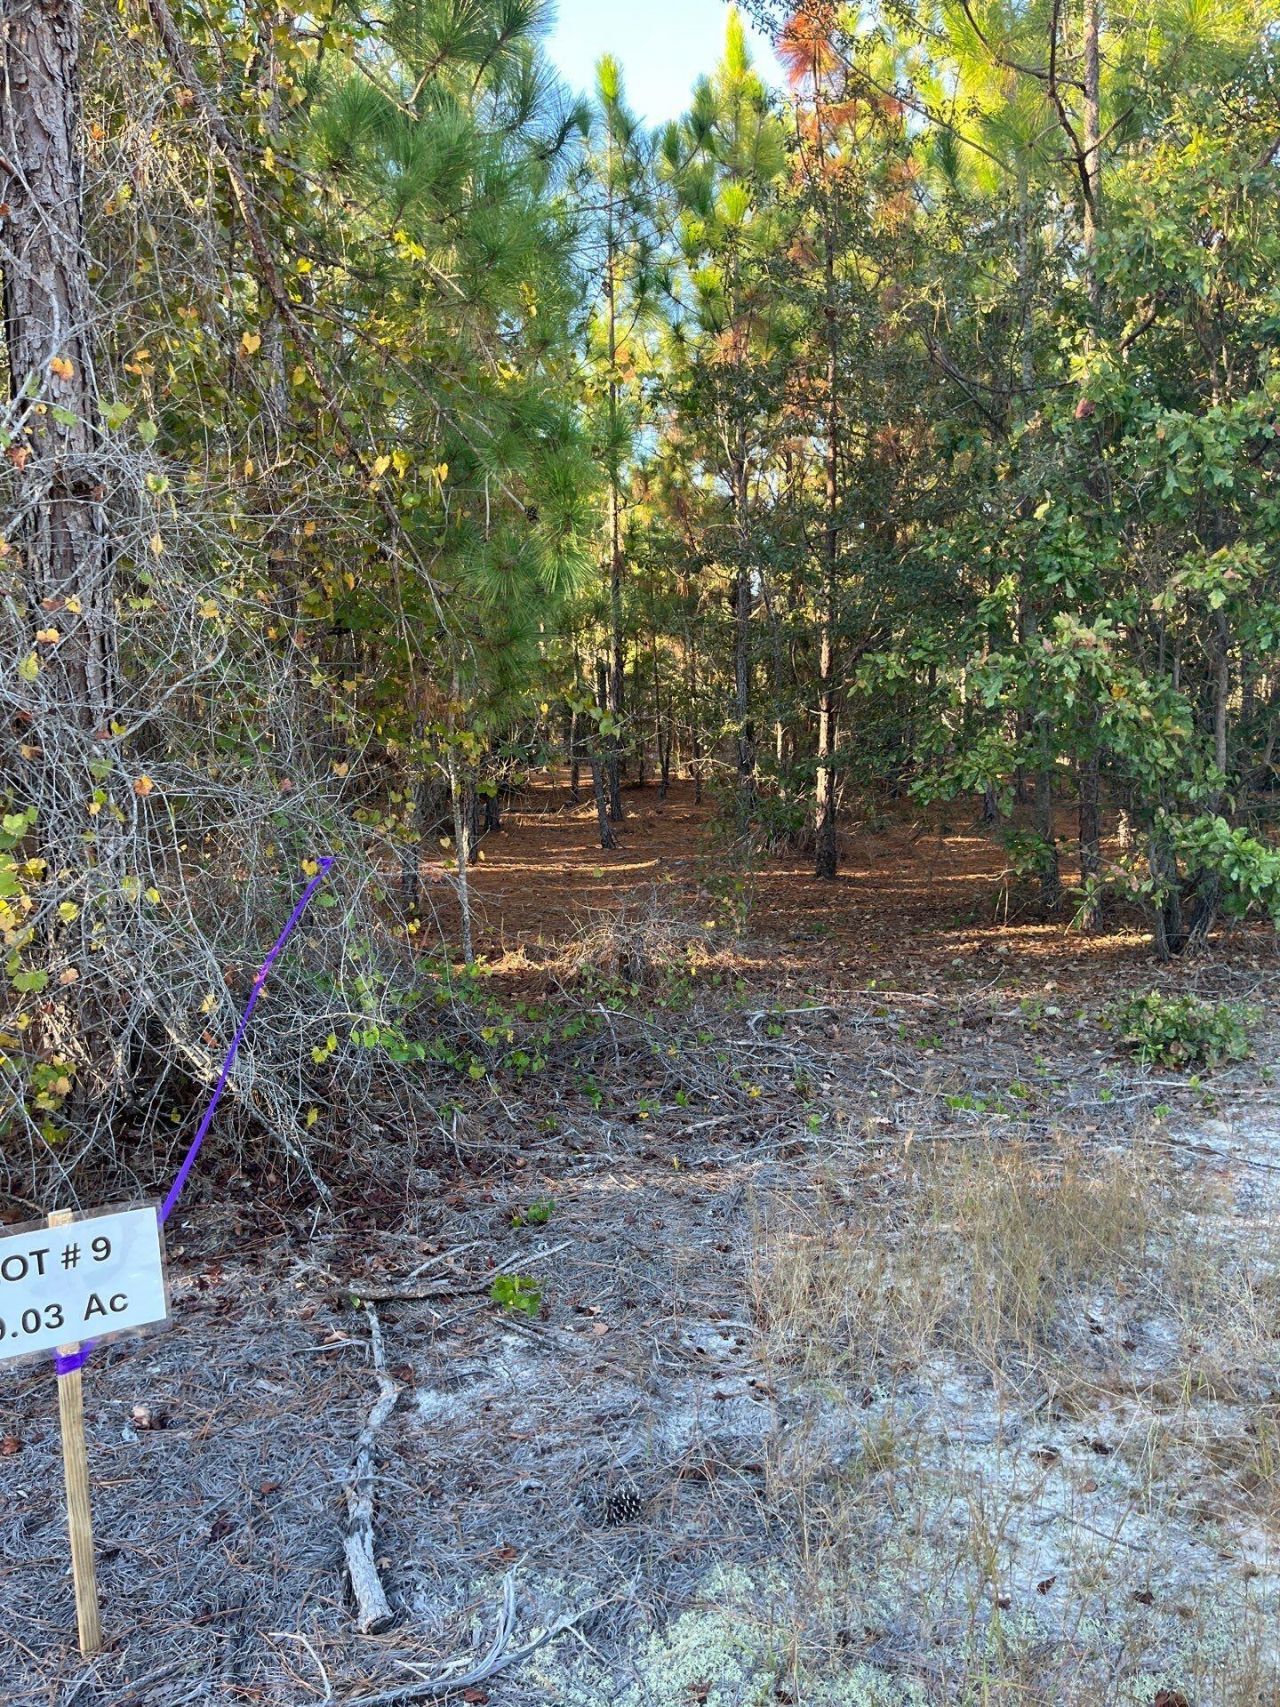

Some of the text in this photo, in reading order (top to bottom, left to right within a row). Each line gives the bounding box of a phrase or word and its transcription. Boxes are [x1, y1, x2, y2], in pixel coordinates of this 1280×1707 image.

[0, 1236, 112, 1283] OT # 9
[0, 1292, 129, 1341] .03 Ac
